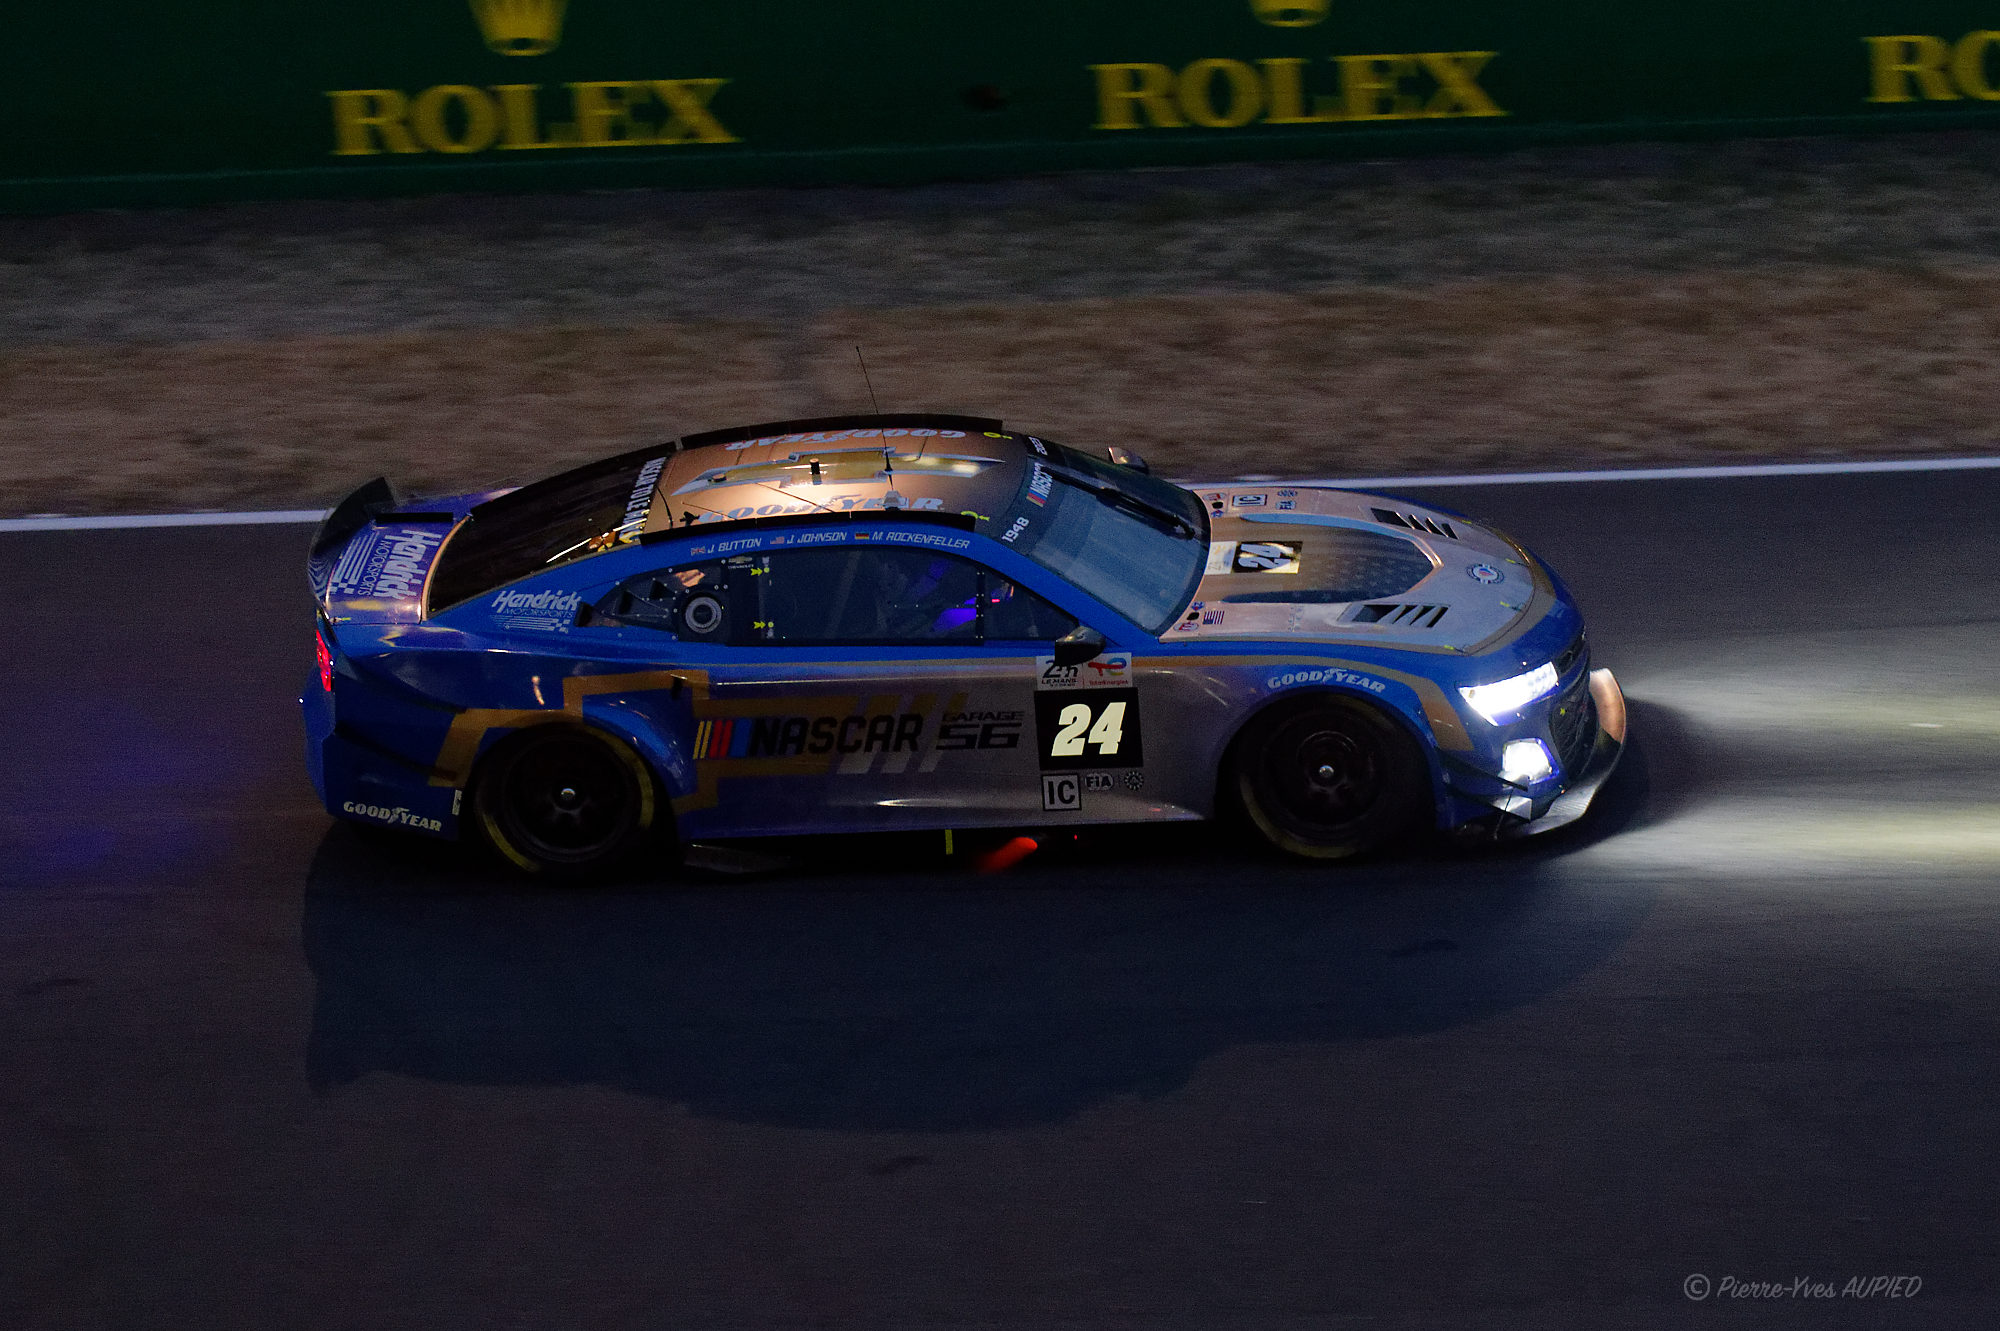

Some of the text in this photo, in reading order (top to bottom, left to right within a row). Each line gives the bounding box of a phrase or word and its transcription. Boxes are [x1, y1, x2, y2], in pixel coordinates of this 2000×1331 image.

[1086, 51, 1512, 129] ROLEX
[324, 77, 744, 156] ROLEX
[797, 532, 847, 543] JOHNSON
[886, 532, 970, 549] ROCKENFELLER
[1001, 517, 1030, 542] 1948
[718, 538, 762, 552] BUTTON
[358, 540, 392, 596] MOTORSPORTS
[373, 530, 443, 599] Hendrick
[491, 590, 582, 613] Hendrick
[1267, 667, 1386, 693] GOODYEAR
[750, 714, 924, 756] NASCAR
[936, 722, 1022, 750] 56
[1051, 702, 1127, 757] 24
[1048, 780, 1075, 805] IC
[343, 801, 442, 832] GOODYEAR
